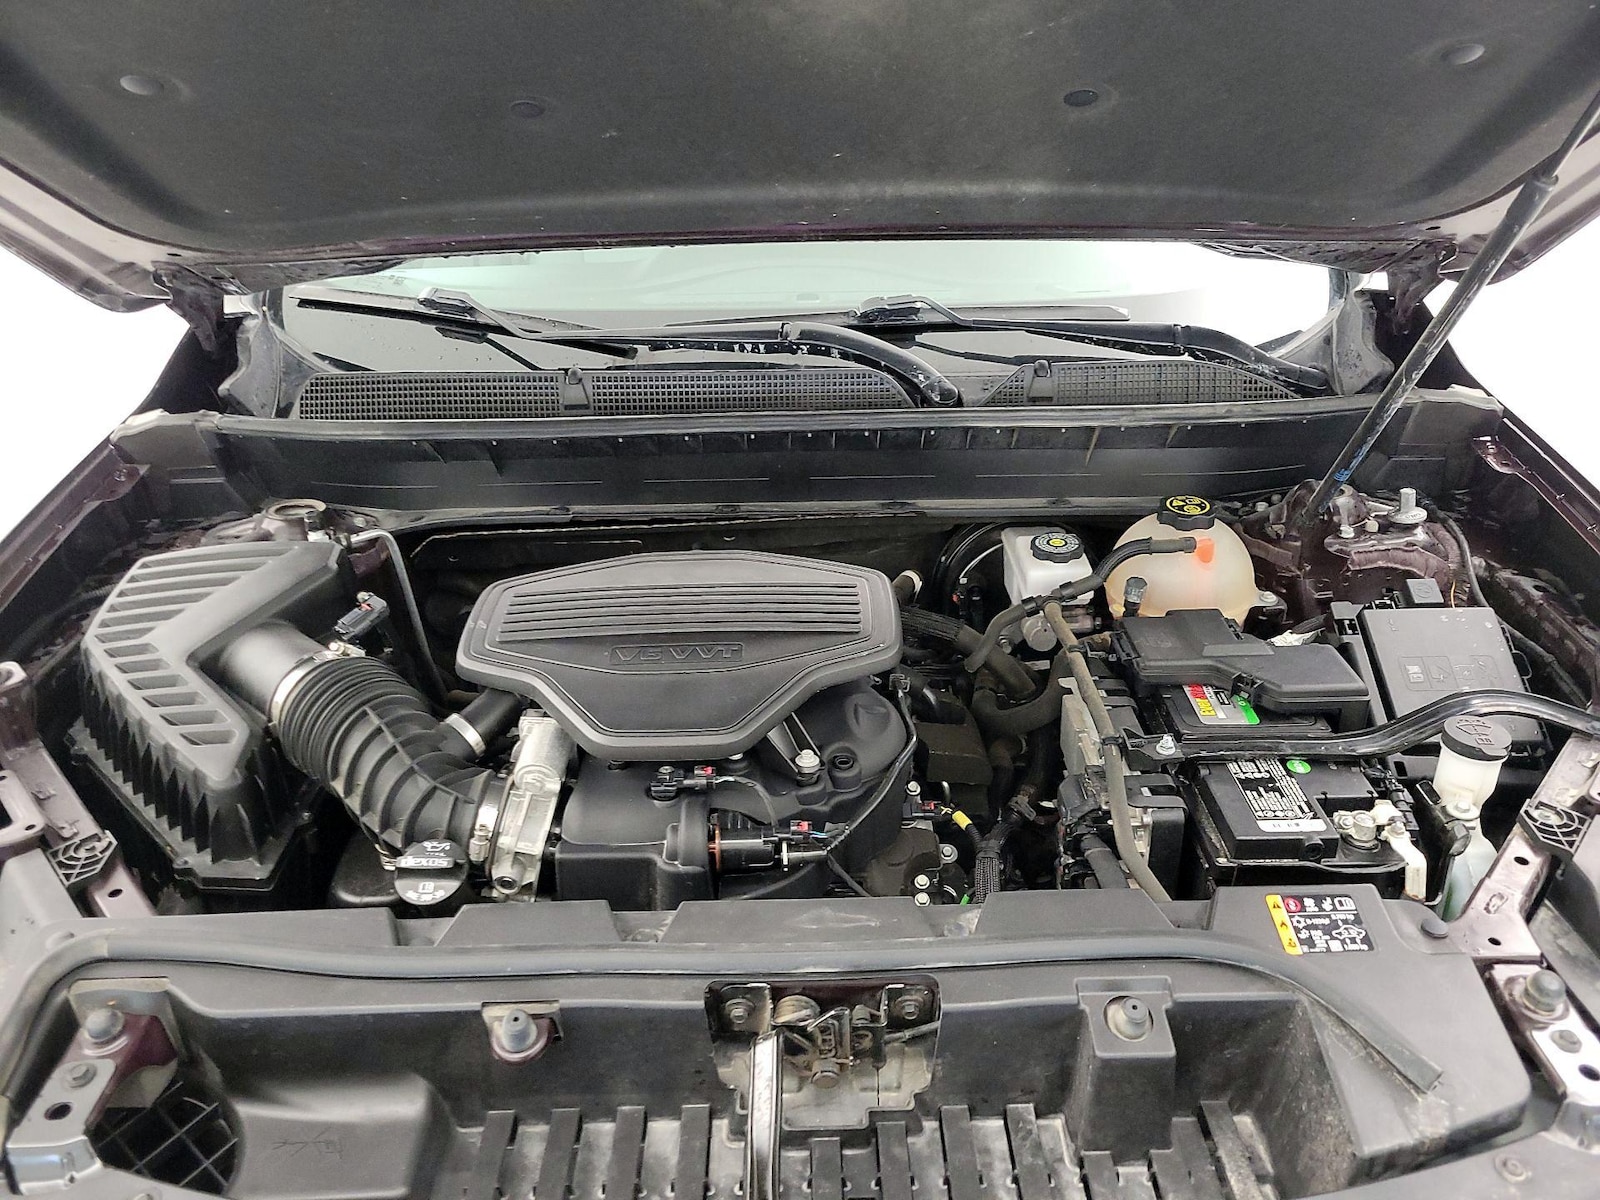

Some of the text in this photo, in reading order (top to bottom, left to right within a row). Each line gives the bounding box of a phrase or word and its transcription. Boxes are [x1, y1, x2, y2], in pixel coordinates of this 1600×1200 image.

[614, 645, 740, 661] V6 VVT
[400, 856, 448, 868] dexos
